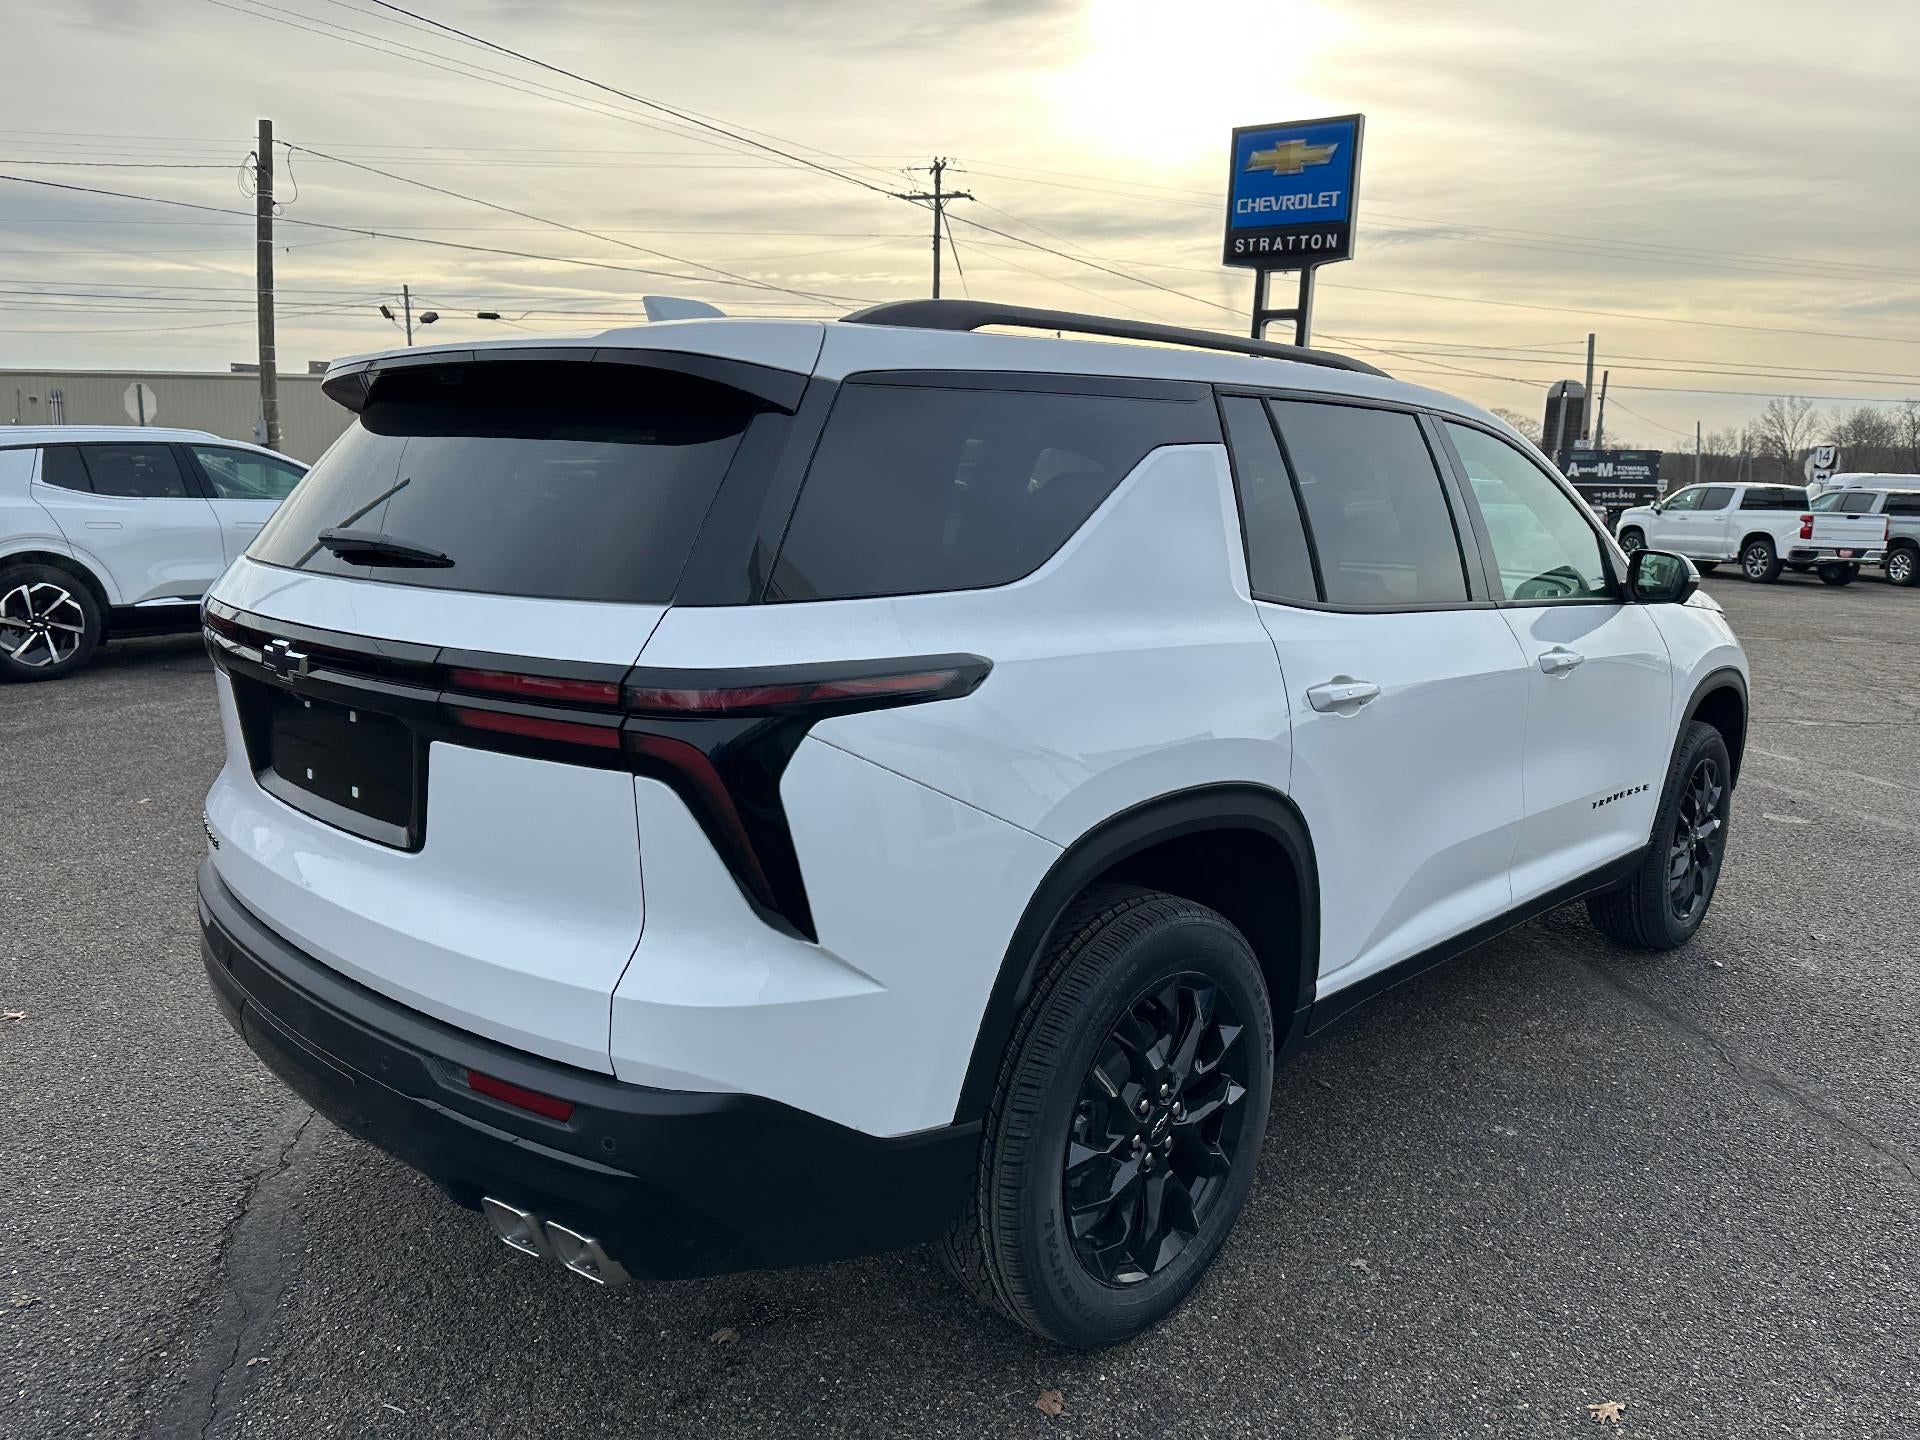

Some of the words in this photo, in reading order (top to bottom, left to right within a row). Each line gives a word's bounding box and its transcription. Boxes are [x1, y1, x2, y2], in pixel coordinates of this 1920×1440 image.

[1237, 191, 1341, 214] CHEVROLET
[1235, 233, 1338, 253] STRATTON
[1819, 450, 1830, 463] 14
[1592, 784, 1650, 809] TRAVERSE
